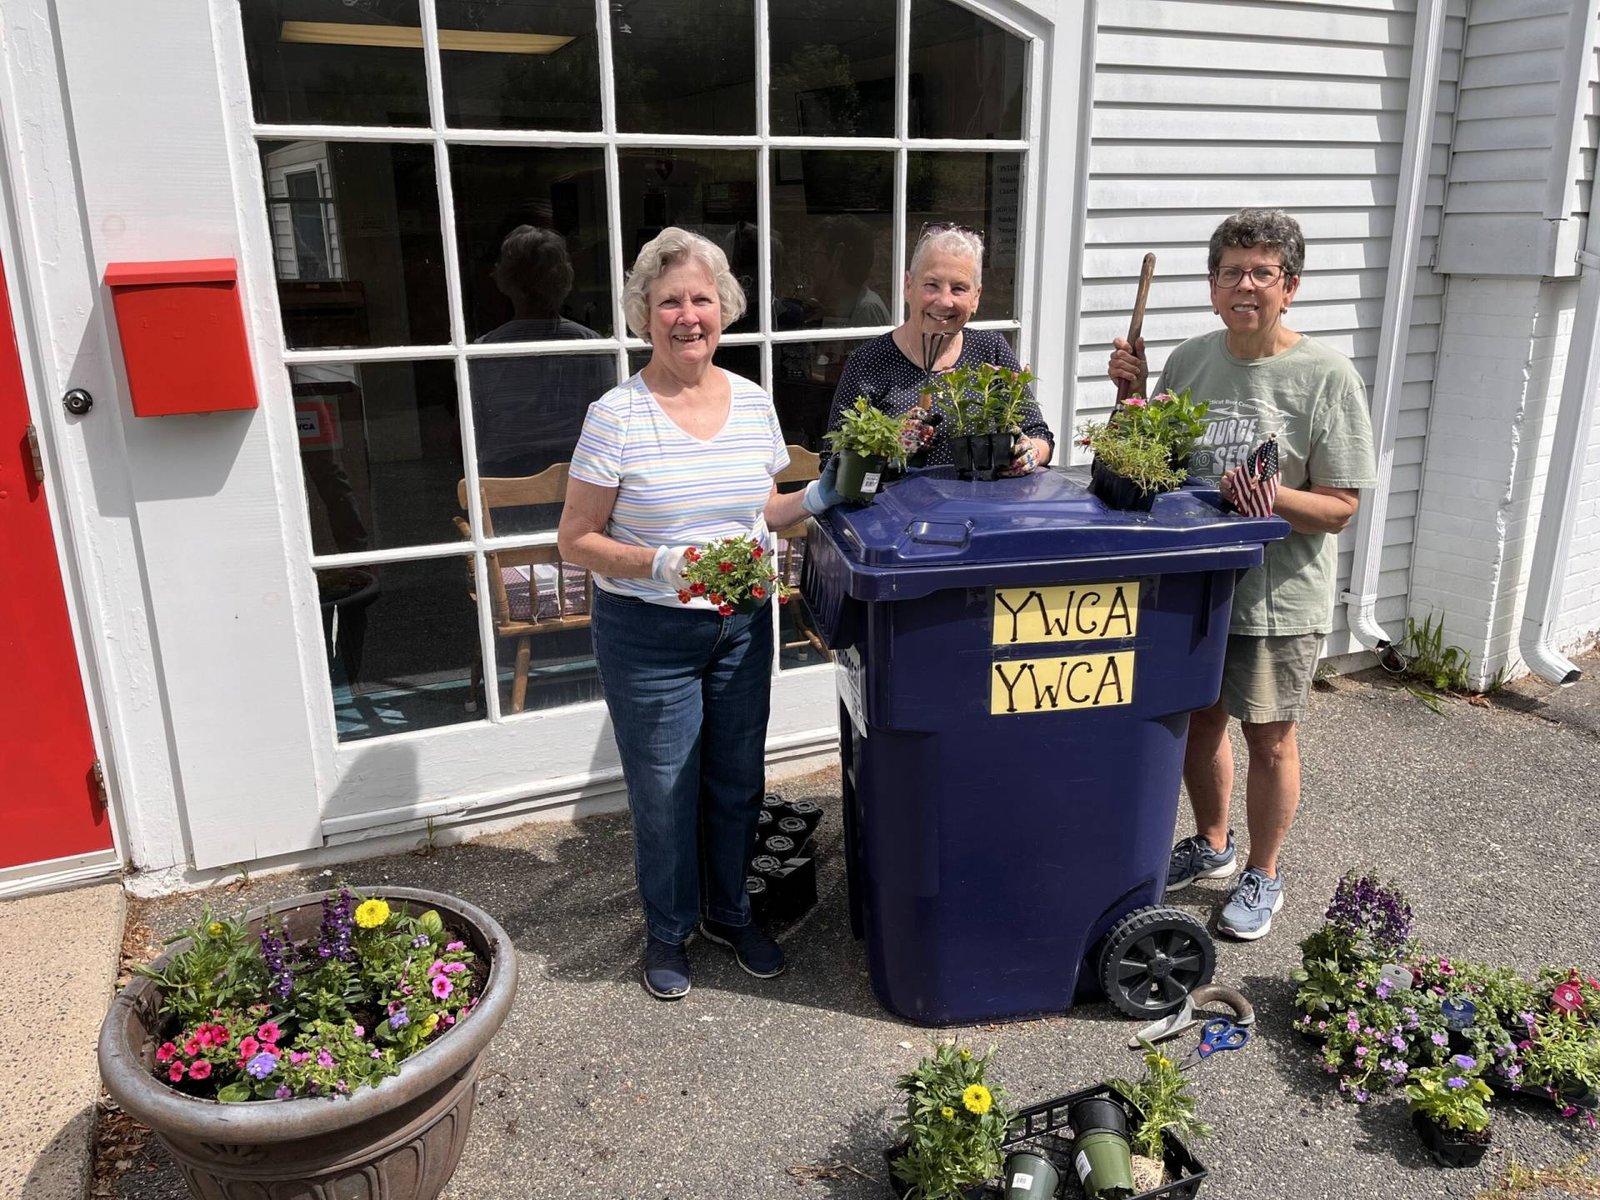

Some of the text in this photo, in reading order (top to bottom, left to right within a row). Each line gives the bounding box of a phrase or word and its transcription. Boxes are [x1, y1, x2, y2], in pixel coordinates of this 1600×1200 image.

[1213, 444, 1249, 475] SEA
[996, 586, 1132, 642] YWCA
[995, 656, 1123, 712] YWCA
